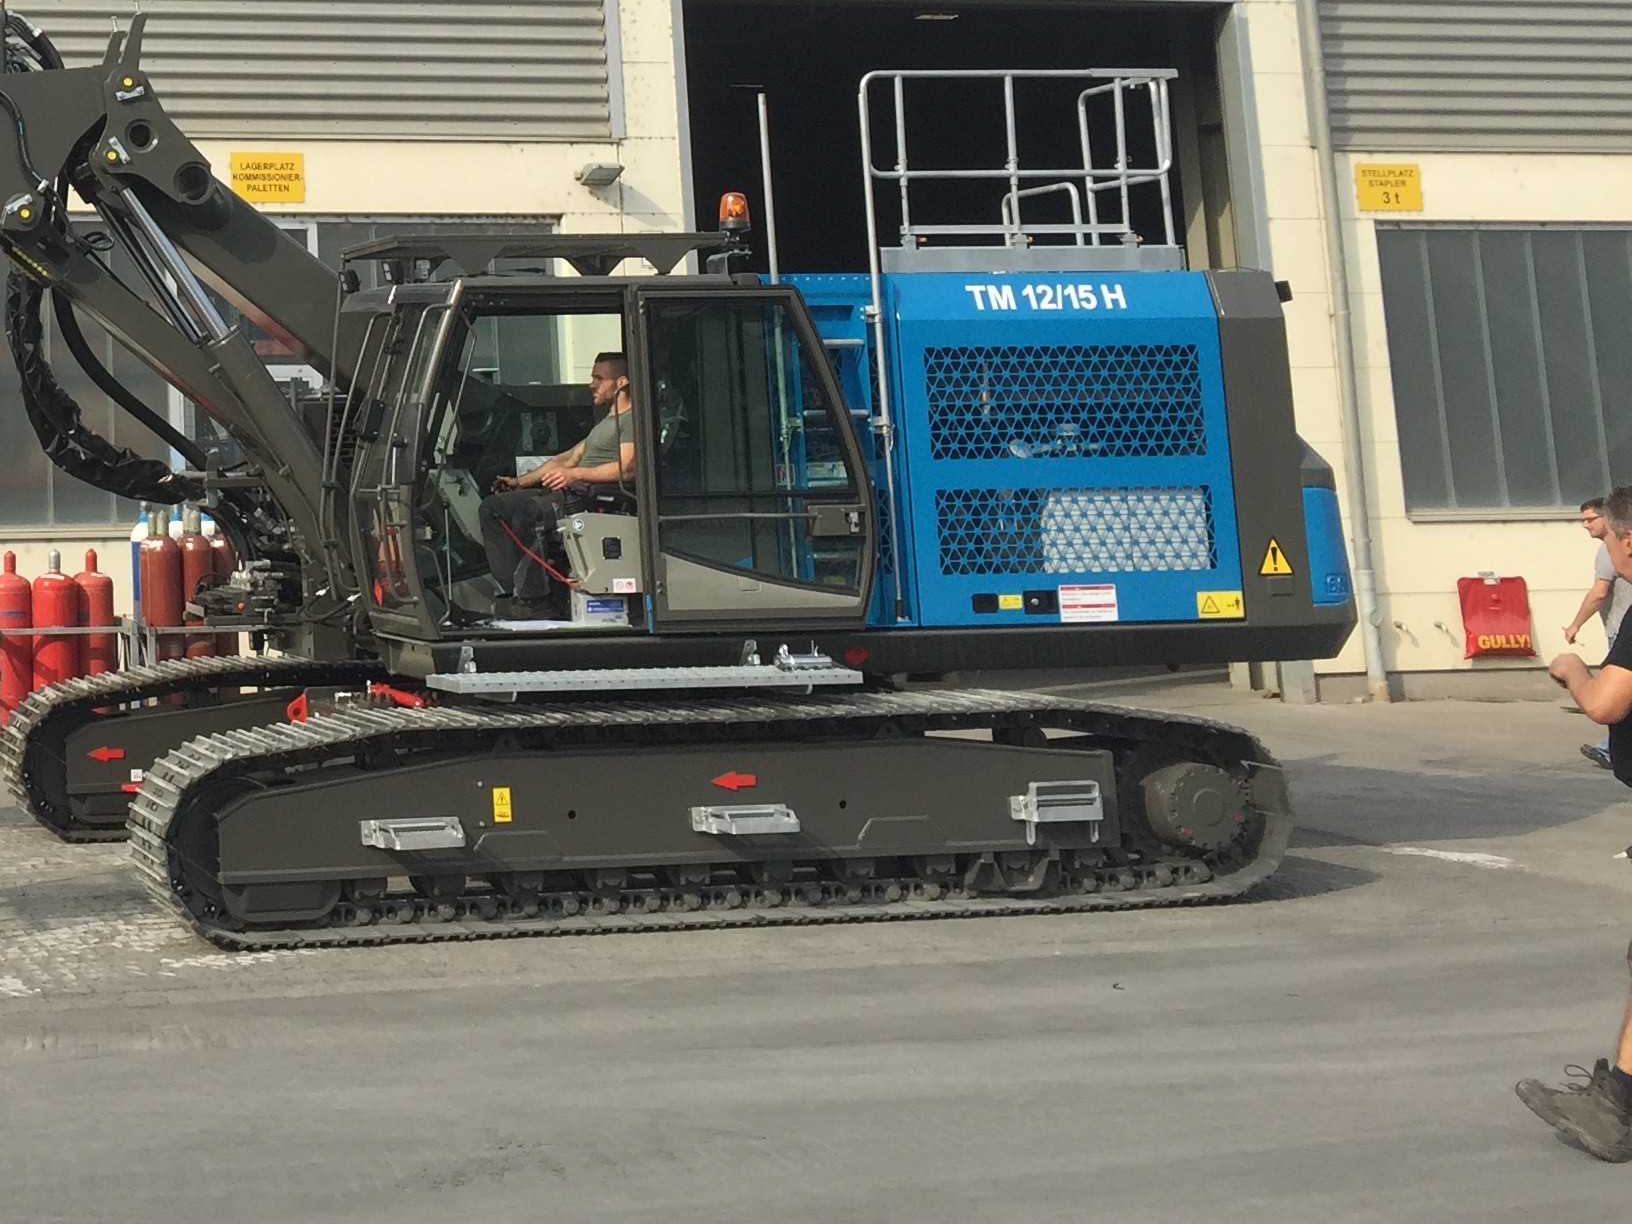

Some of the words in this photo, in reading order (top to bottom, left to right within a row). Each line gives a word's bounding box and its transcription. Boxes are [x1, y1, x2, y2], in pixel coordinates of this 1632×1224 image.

[239, 162, 295, 171] LAGERPLATZ
[233, 173, 304, 182] KOMMISSIONIER-
[1361, 169, 1415, 178] STELLPLATZ
[1368, 179, 1407, 188] STAPLER
[246, 184, 290, 193] PALETTEN
[1382, 191, 1391, 204] 3
[965, 284, 1017, 311] TM
[1021, 284, 1098, 310] 12/15
[1099, 283, 1128, 309] H
[1477, 633, 1532, 649] GULLY!
